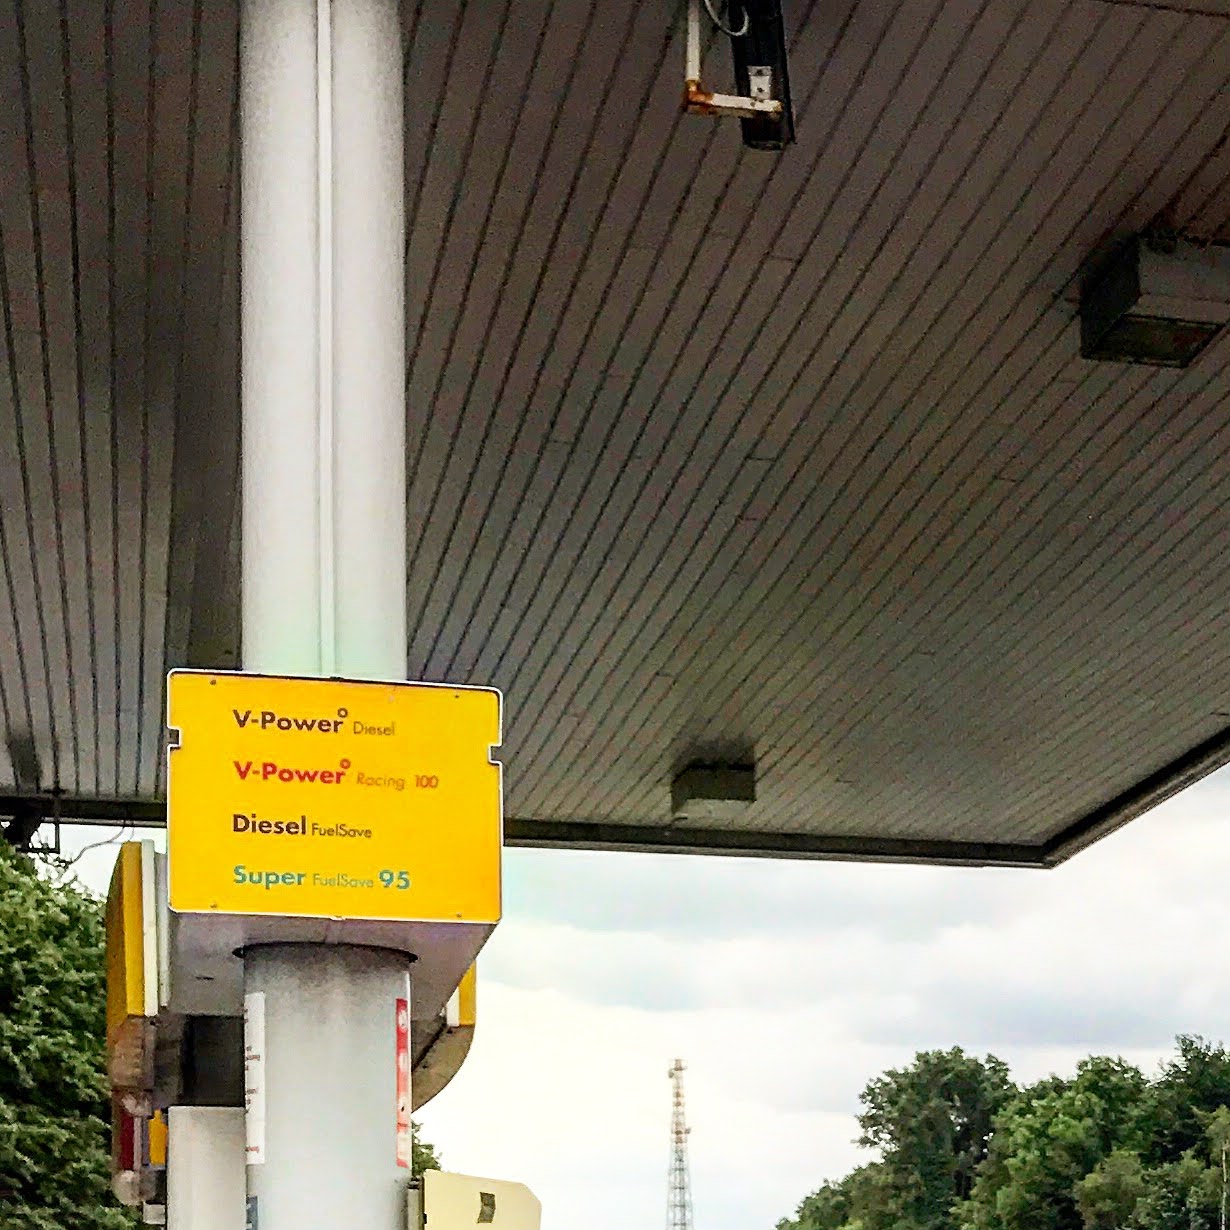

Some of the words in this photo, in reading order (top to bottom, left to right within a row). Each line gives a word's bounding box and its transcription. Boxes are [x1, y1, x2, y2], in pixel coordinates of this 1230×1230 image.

[352, 721, 396, 736] Diesel
[356, 772, 405, 790] Racing
[414, 774, 440, 789] 100
[232, 813, 307, 836] Diesel
[311, 823, 373, 839] FuelSave
[233, 865, 306, 891] Super
[312, 872, 374, 889] FuelSave
[378, 869, 411, 890] 95
